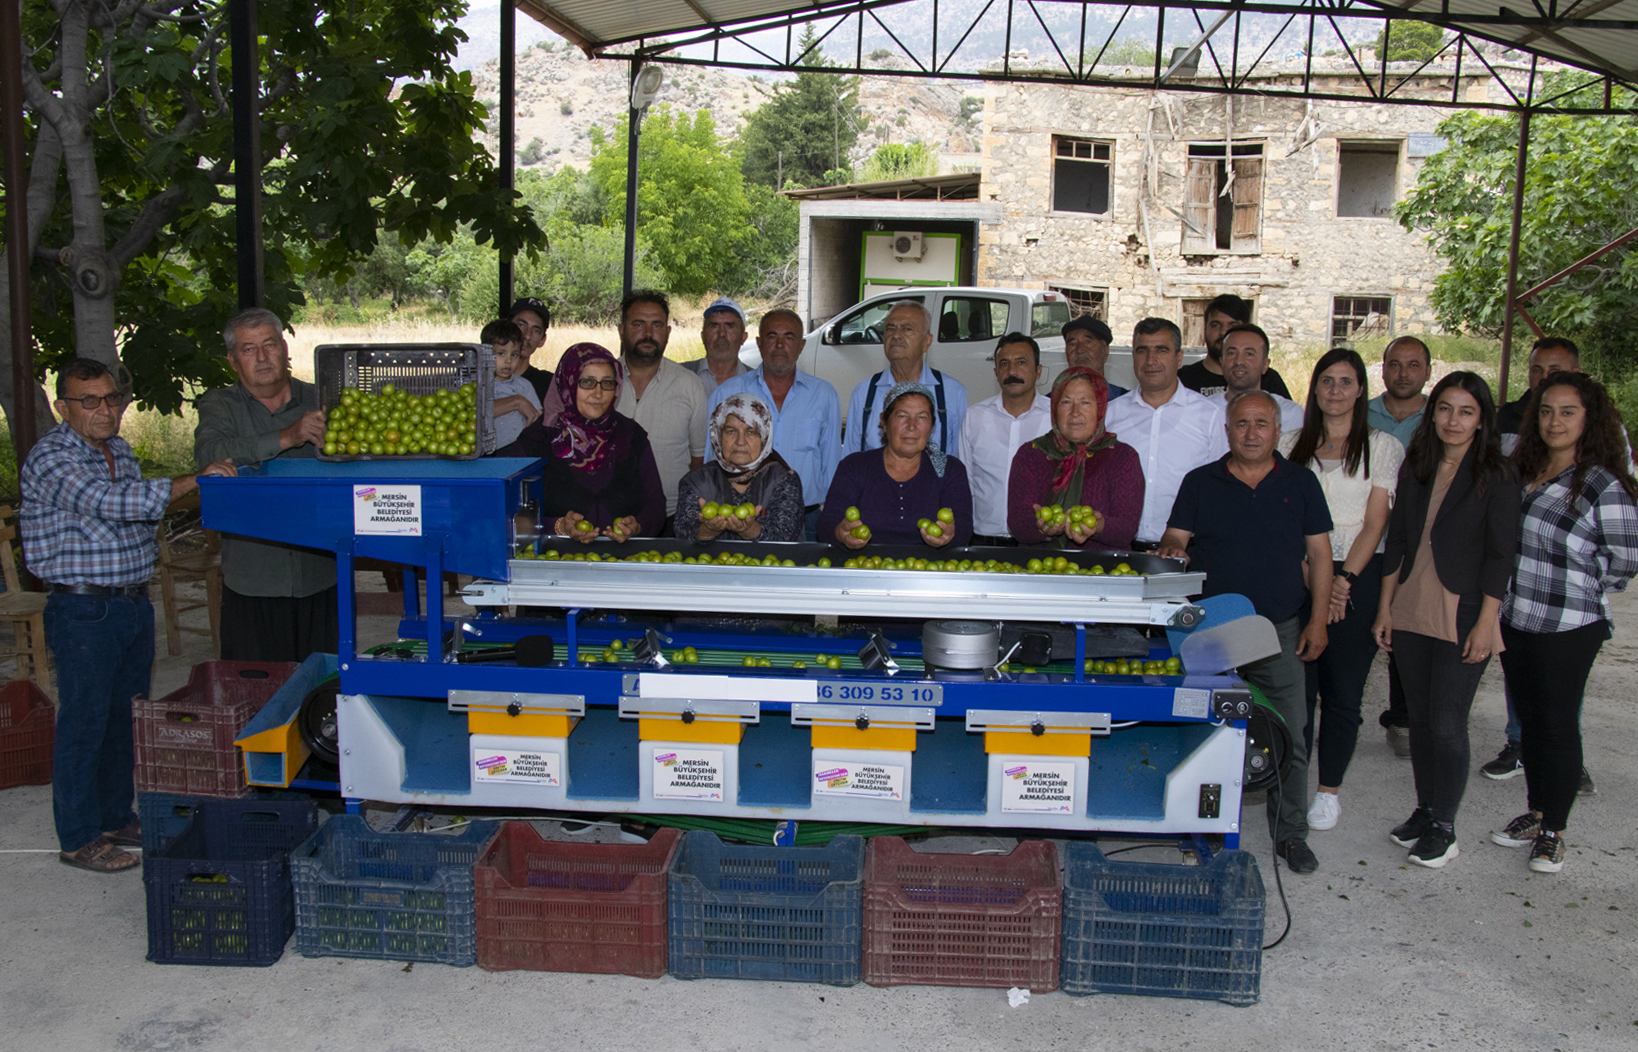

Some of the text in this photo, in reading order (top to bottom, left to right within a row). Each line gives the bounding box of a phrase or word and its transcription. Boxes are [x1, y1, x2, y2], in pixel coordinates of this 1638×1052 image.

[373, 500, 415, 509] BÜYÜKŞEHİR
[370, 515, 419, 523] ARMAĞANIDIR
[839, 685, 874, 700] 309
[880, 687, 904, 701] 53
[911, 688, 934, 702] 10
[159, 727, 209, 739] ADRASOS
[673, 765, 717, 774] BÜYÜKŞEHİR
[677, 773, 714, 781] BELEDİYESİ
[854, 772, 891, 780] BÜYÜKŞEHİR
[1032, 771, 1060, 779] MERSİN
[670, 780, 721, 789] ARMAĞANIDIR
[857, 778, 888, 786] BELEDİYESİ
[1022, 778, 1068, 787] BÜYÜKŞEHİR
[851, 784, 893, 792] ARMAĞANIDIR
[1026, 786, 1064, 794] BELEDİYESİ
[1019, 794, 1071, 802] ARMAĞANIDIR
